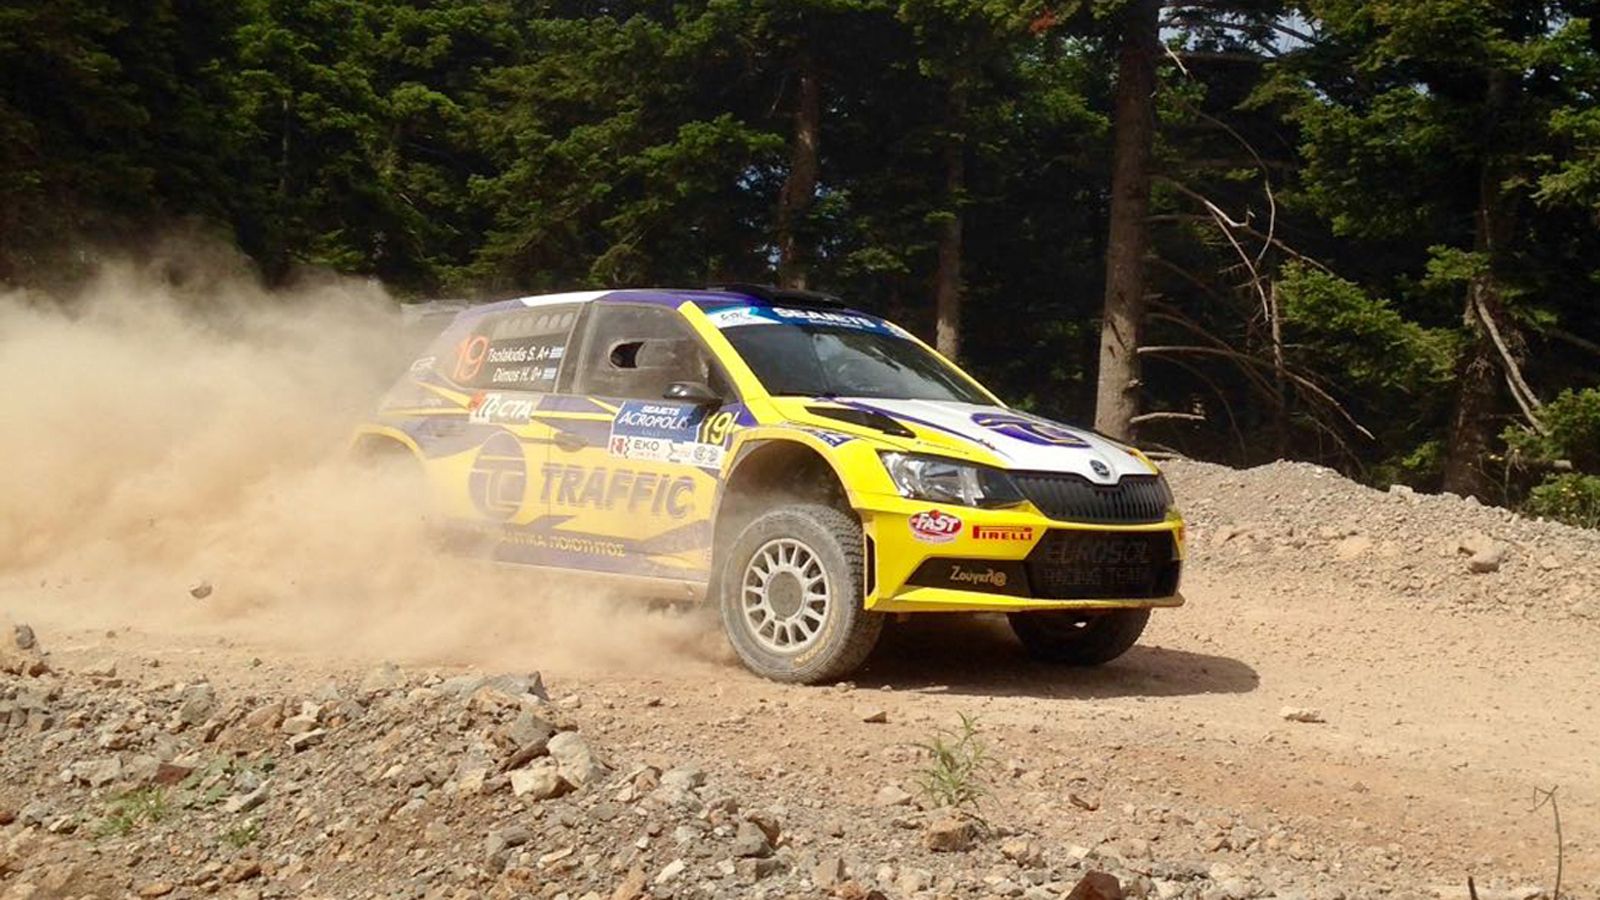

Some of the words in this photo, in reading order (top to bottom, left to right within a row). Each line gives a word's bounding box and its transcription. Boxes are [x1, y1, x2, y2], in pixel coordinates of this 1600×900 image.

[453, 335, 488, 380] 19
[492, 366, 520, 382] Dimos
[703, 411, 732, 445] 19
[633, 439, 659, 451] EKO
[540, 462, 695, 519] TRAFFIC
[973, 525, 1034, 540] PIRELLI
